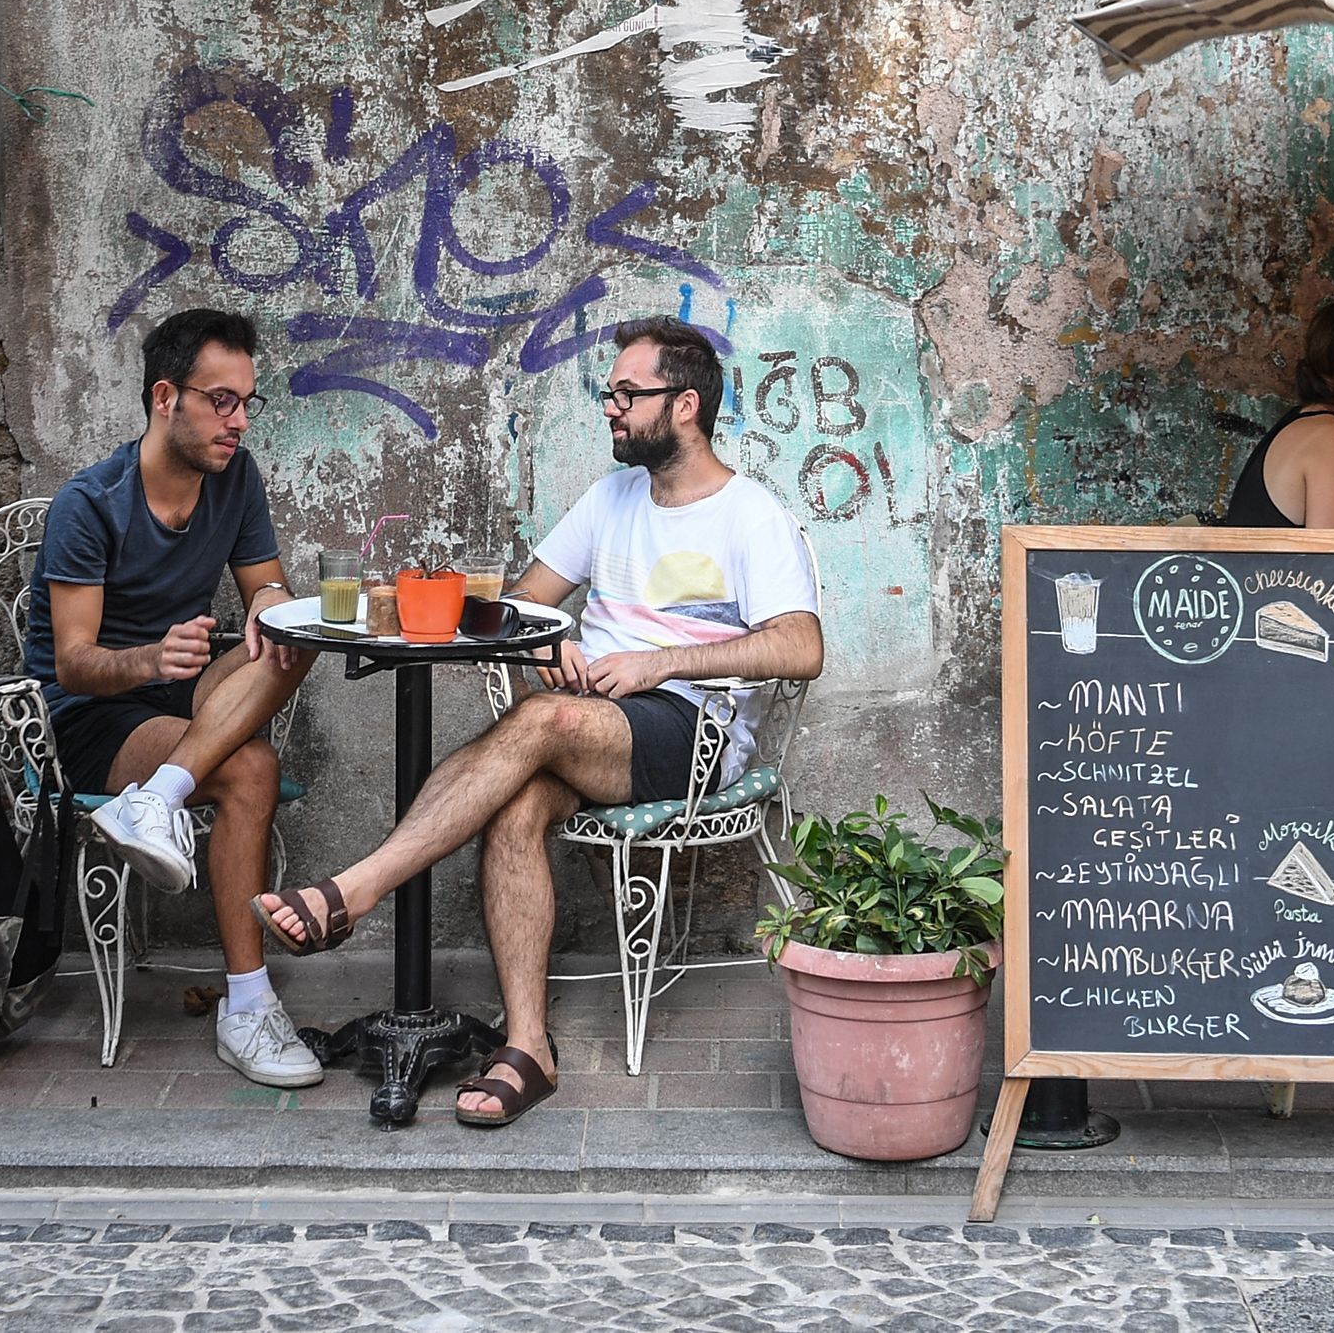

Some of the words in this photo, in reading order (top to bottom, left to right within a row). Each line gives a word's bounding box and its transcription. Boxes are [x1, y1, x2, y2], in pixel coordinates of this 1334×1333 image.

[1068, 679, 1183, 716] MANTI
[1067, 719, 1174, 756] KÖFTE
[1058, 761, 1199, 788] SCHNITZEL
[1063, 792, 1172, 824] SALATA
[1061, 898, 1234, 932] MAKARNA
[1274, 898, 1323, 924] Pasta
[1064, 942, 1240, 984] HAMBURGER
[1060, 984, 1176, 1009] CHICKEN
[1123, 1013, 1251, 1041] BURGER
